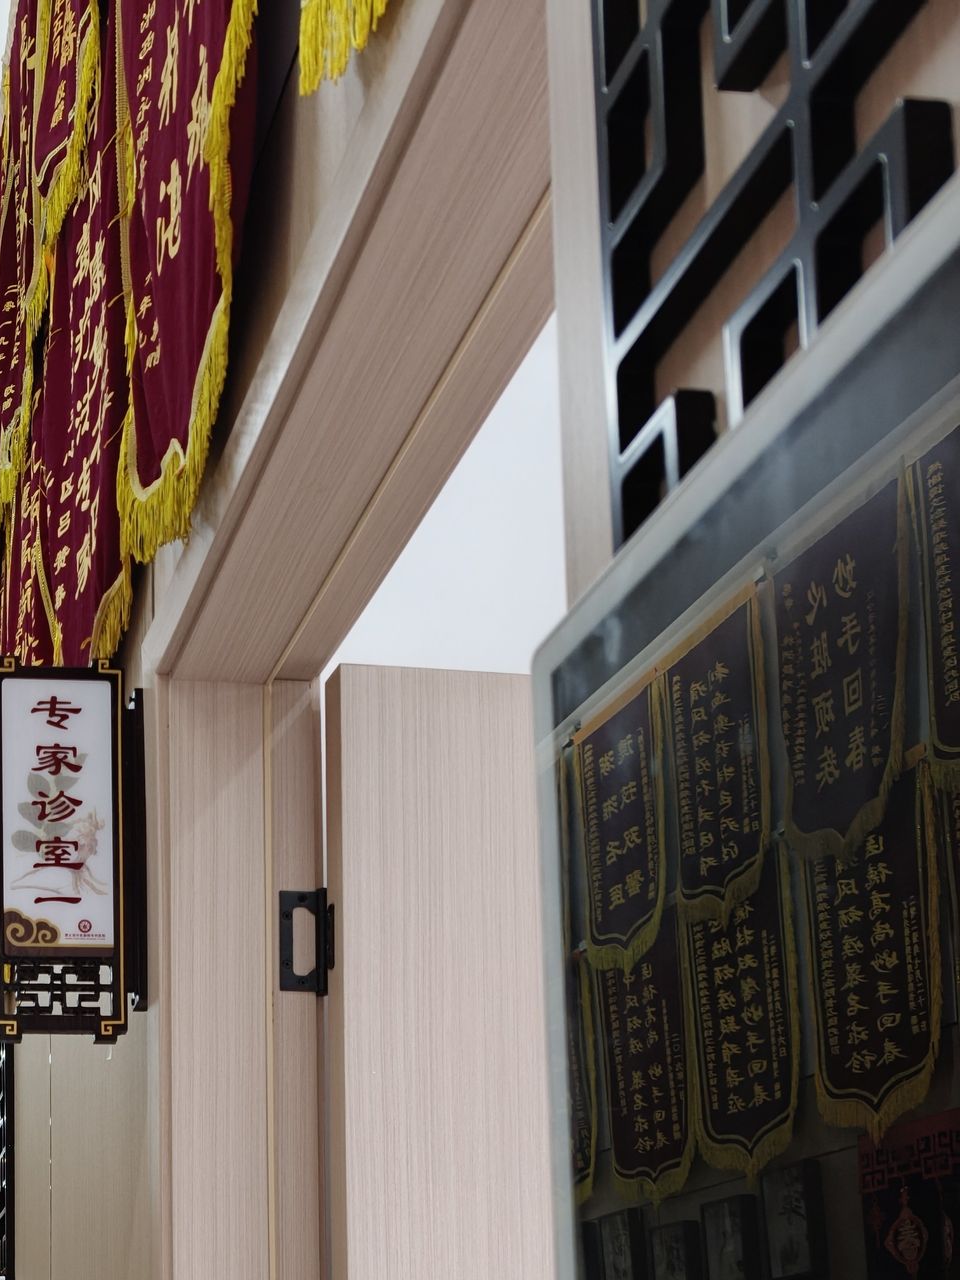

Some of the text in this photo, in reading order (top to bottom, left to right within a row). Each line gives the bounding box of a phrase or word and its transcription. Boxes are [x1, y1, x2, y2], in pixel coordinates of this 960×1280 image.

[30, 695, 86, 906] 专家诊室一
